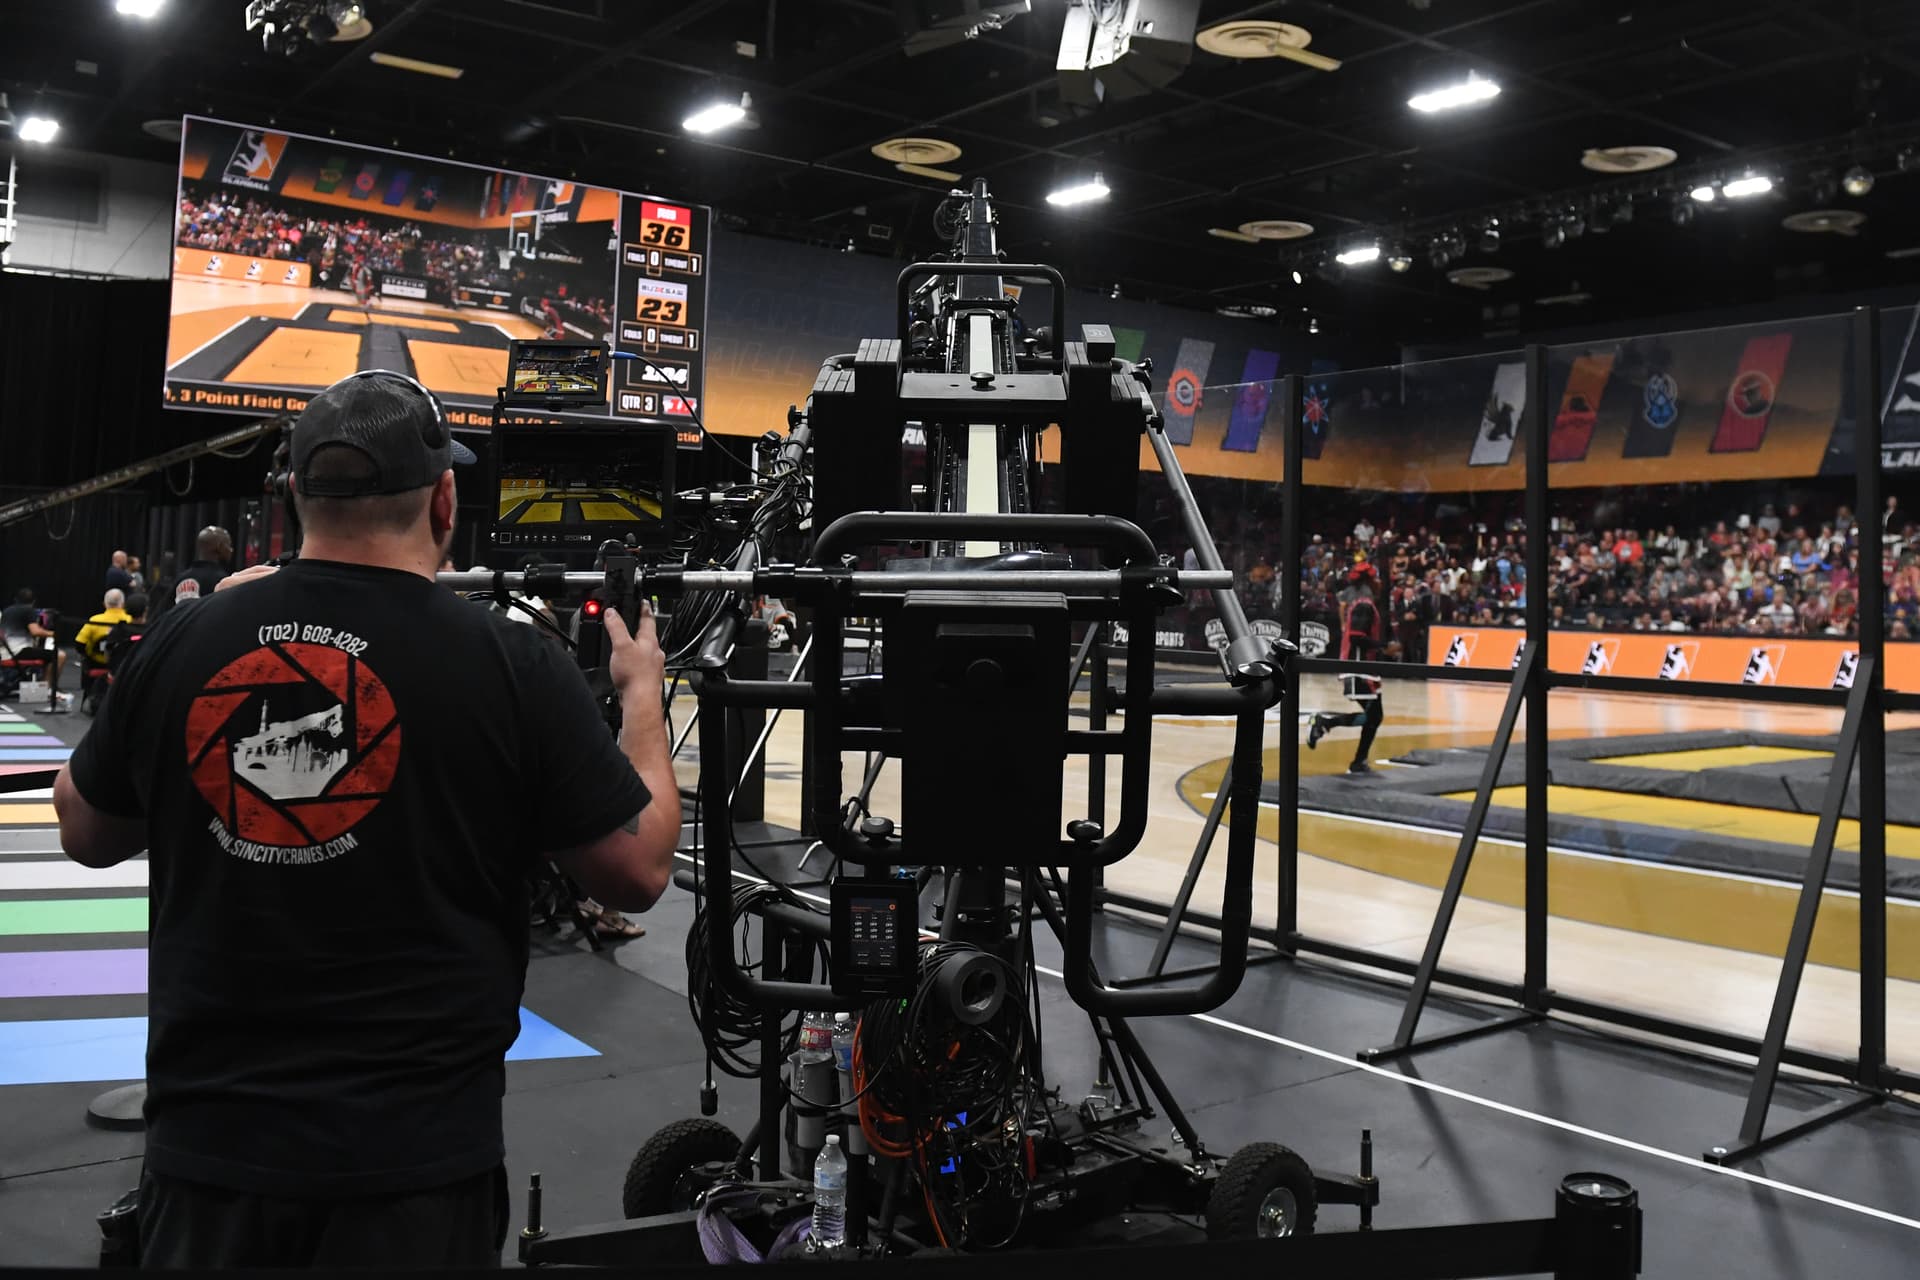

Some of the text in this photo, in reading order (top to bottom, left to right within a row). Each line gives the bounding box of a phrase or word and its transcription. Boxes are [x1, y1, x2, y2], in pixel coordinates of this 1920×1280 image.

[643, 222, 685, 247] 36
[650, 251, 659, 266] 0
[692, 257, 697, 272] 1
[640, 297, 682, 321] 23
[647, 328, 656, 342] 0
[689, 334, 695, 348] 1
[180, 389, 191, 402] 3
[195, 390, 239, 406] Point
[243, 394, 283, 409] Field
[622, 394, 653, 412] QTR 3
[258, 621, 368, 657] (702) 608-4282
[208, 816, 359, 865] WWW.SINCITYCRANES.COM
